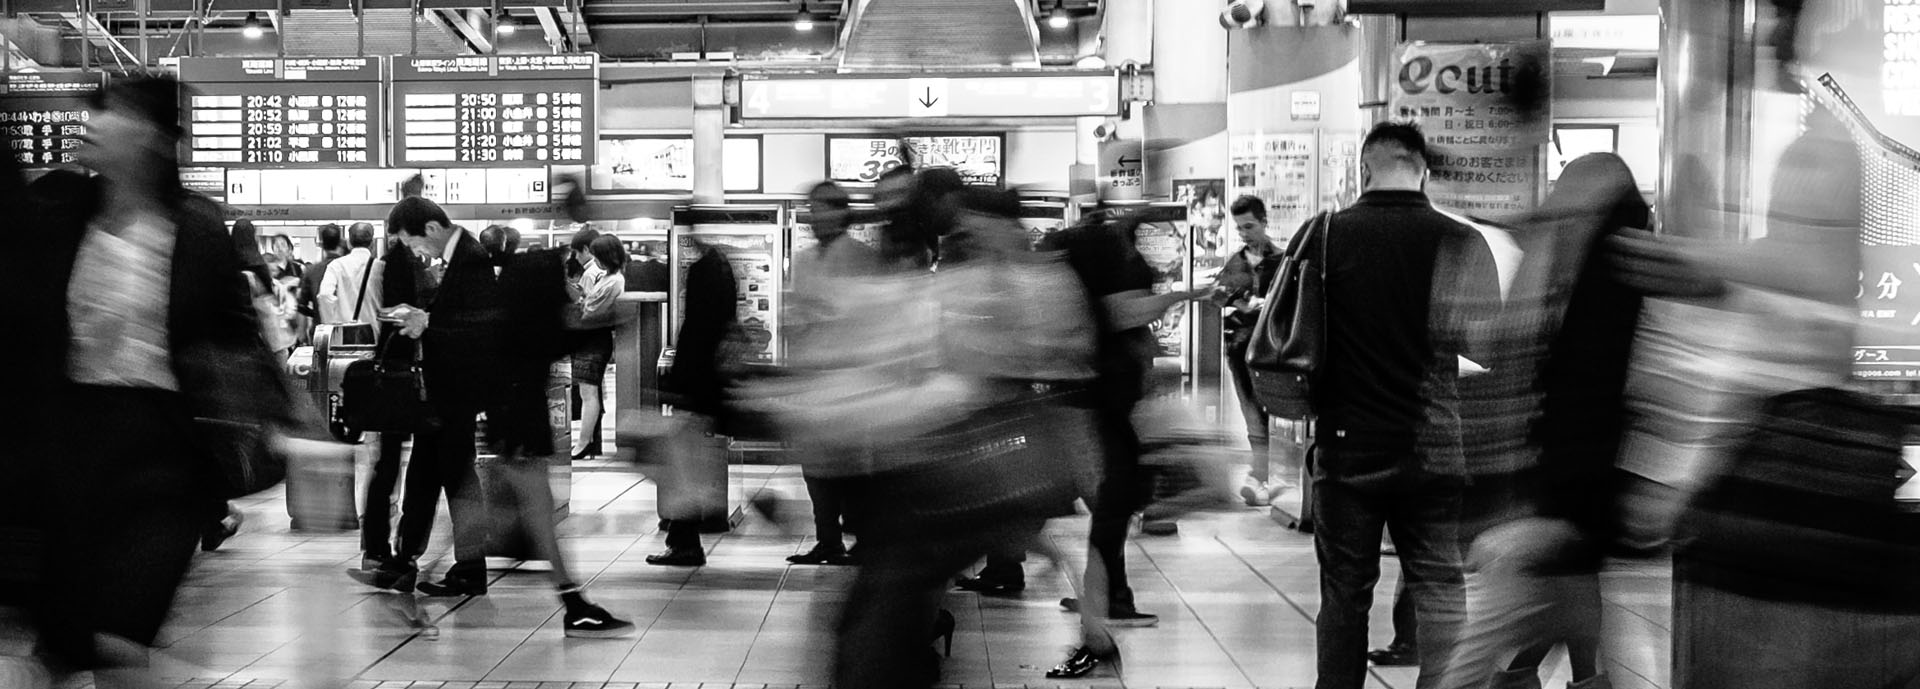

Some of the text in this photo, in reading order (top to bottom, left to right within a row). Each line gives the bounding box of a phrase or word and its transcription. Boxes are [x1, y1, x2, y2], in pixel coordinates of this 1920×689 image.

[247, 95, 282, 108] 20:42
[460, 93, 497, 107] 20:50
[748, 83, 771, 114] 4
[1088, 80, 1110, 113] 3
[247, 109, 282, 122] 20:52
[460, 107, 497, 121] 21:00
[247, 123, 282, 136] 20:59
[460, 120, 497, 134] 21:11
[247, 136, 282, 149] 21:02
[460, 134, 497, 149] 21:20
[247, 150, 282, 163] 21:10
[460, 148, 497, 162] 21:30
[1877, 271, 1902, 300] 分
